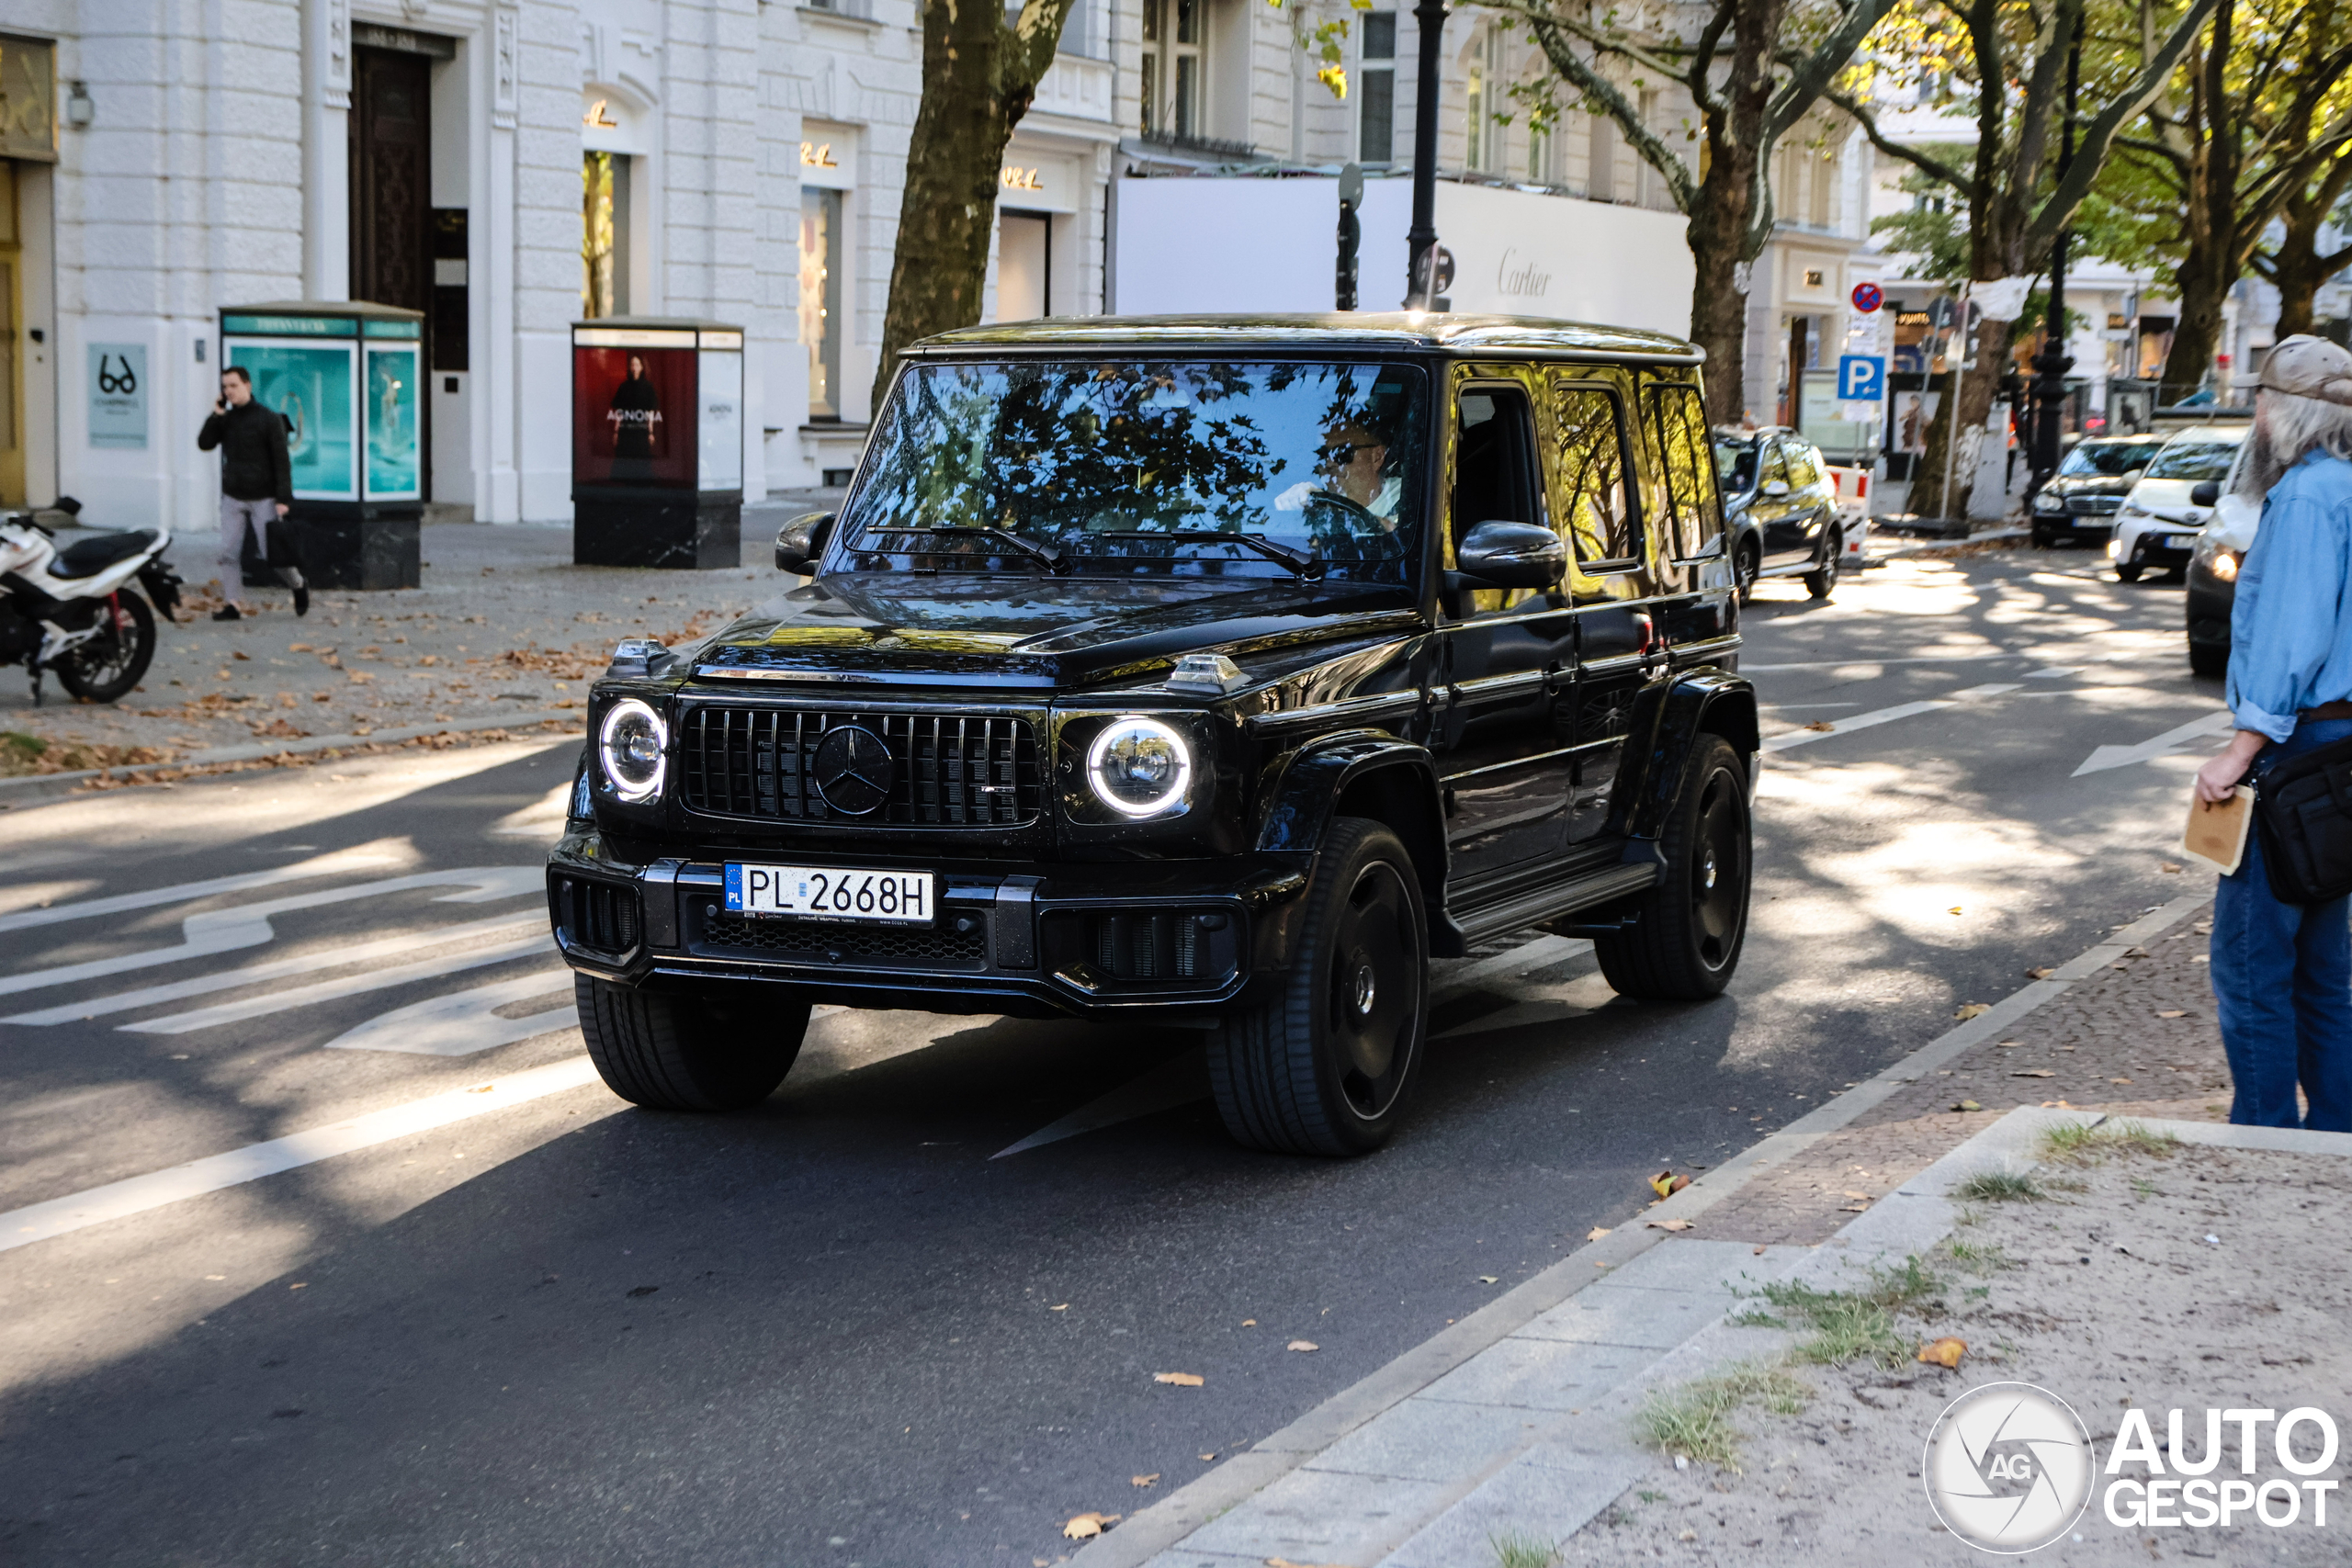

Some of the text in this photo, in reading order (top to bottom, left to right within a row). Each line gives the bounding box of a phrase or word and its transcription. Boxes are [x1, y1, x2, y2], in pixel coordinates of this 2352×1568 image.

[1498, 246, 1552, 297] Cartier
[1847, 359, 1875, 396] P
[728, 892, 741, 903] PL
[750, 869, 923, 916] PL 2668H
